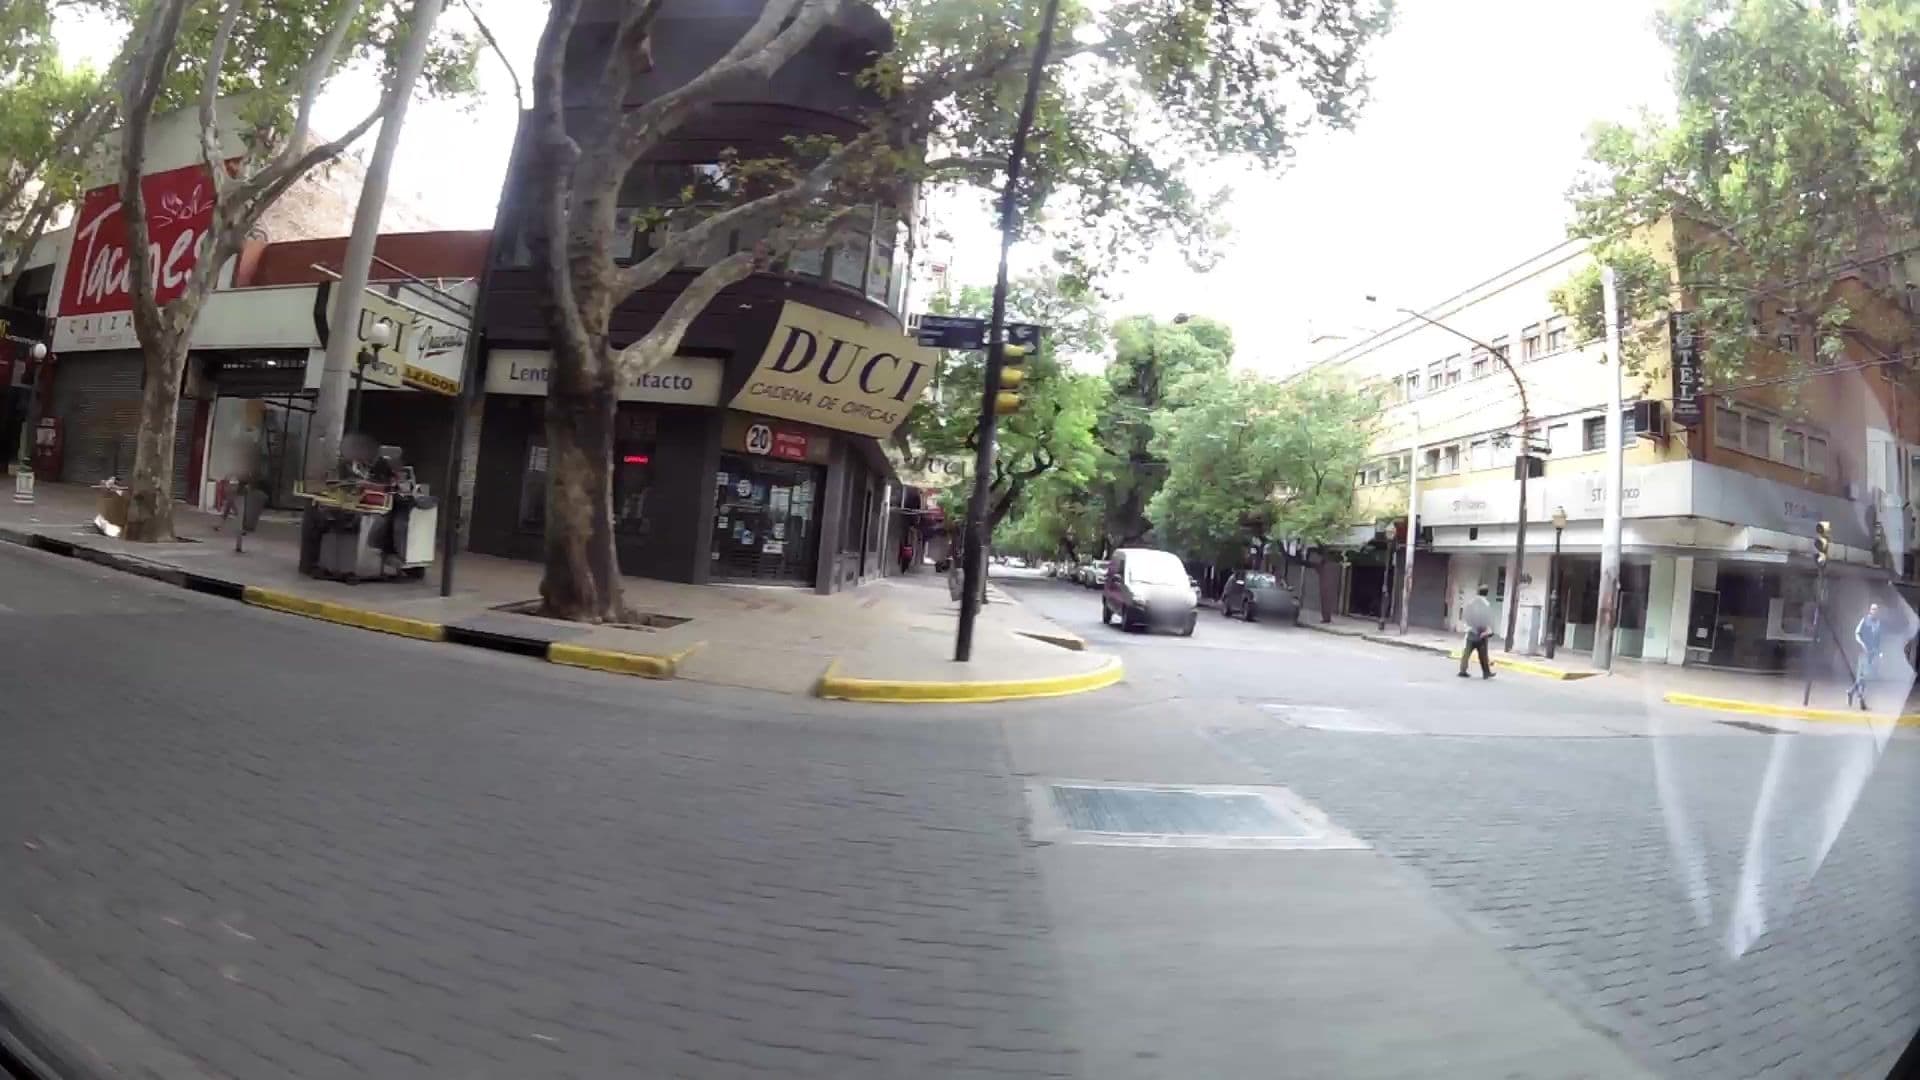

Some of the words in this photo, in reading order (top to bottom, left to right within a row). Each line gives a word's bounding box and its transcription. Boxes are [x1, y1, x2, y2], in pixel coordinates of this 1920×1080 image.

[510, 361, 549, 382] Lent
[765, 324, 928, 402] DUCI
[750, 382, 812, 405] CADENA
[817, 395, 840, 410] DE
[841, 401, 898, 425] OPTICAS
[750, 427, 768, 449] 20
